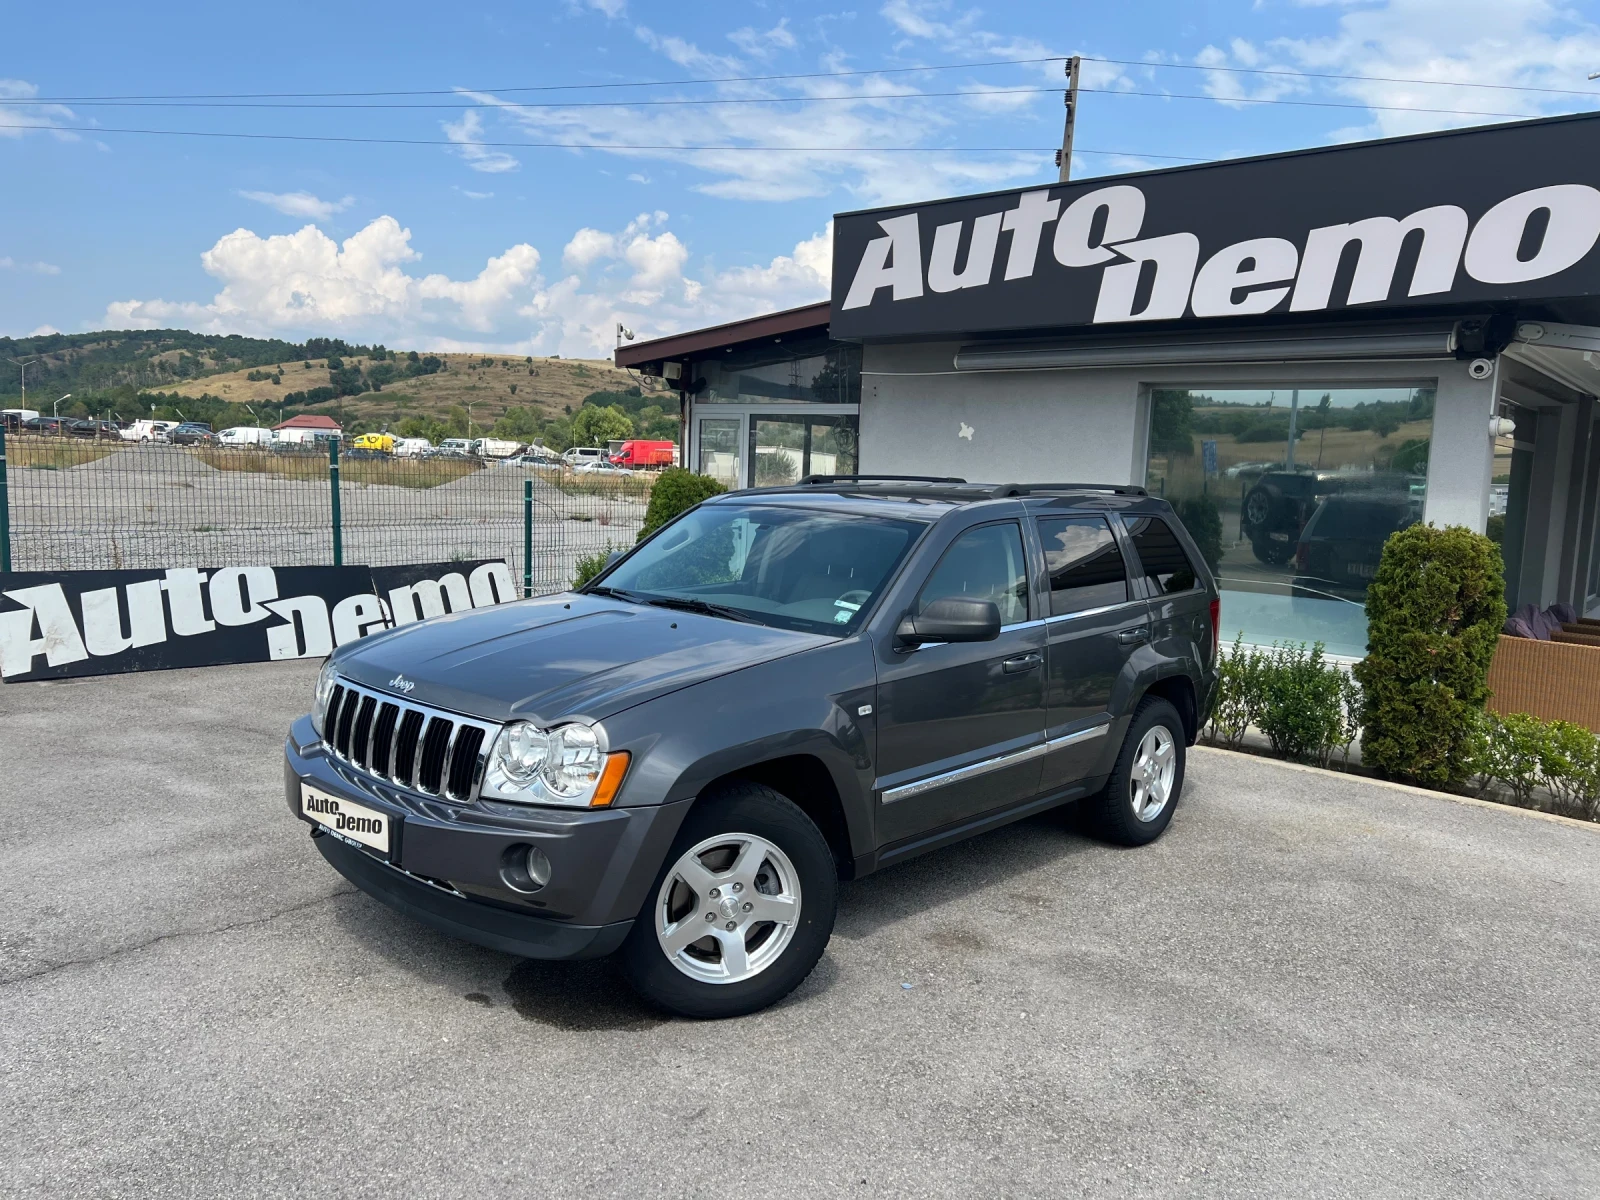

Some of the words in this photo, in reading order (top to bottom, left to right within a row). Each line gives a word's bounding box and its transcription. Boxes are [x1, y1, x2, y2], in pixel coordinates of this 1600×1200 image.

[842, 185, 1146, 310] Auto
[1093, 184, 1600, 324] Demo
[0, 566, 280, 678] Auto
[388, 674, 415, 693] Jeep
[306, 794, 340, 816] Auto
[335, 811, 383, 835] Demo
